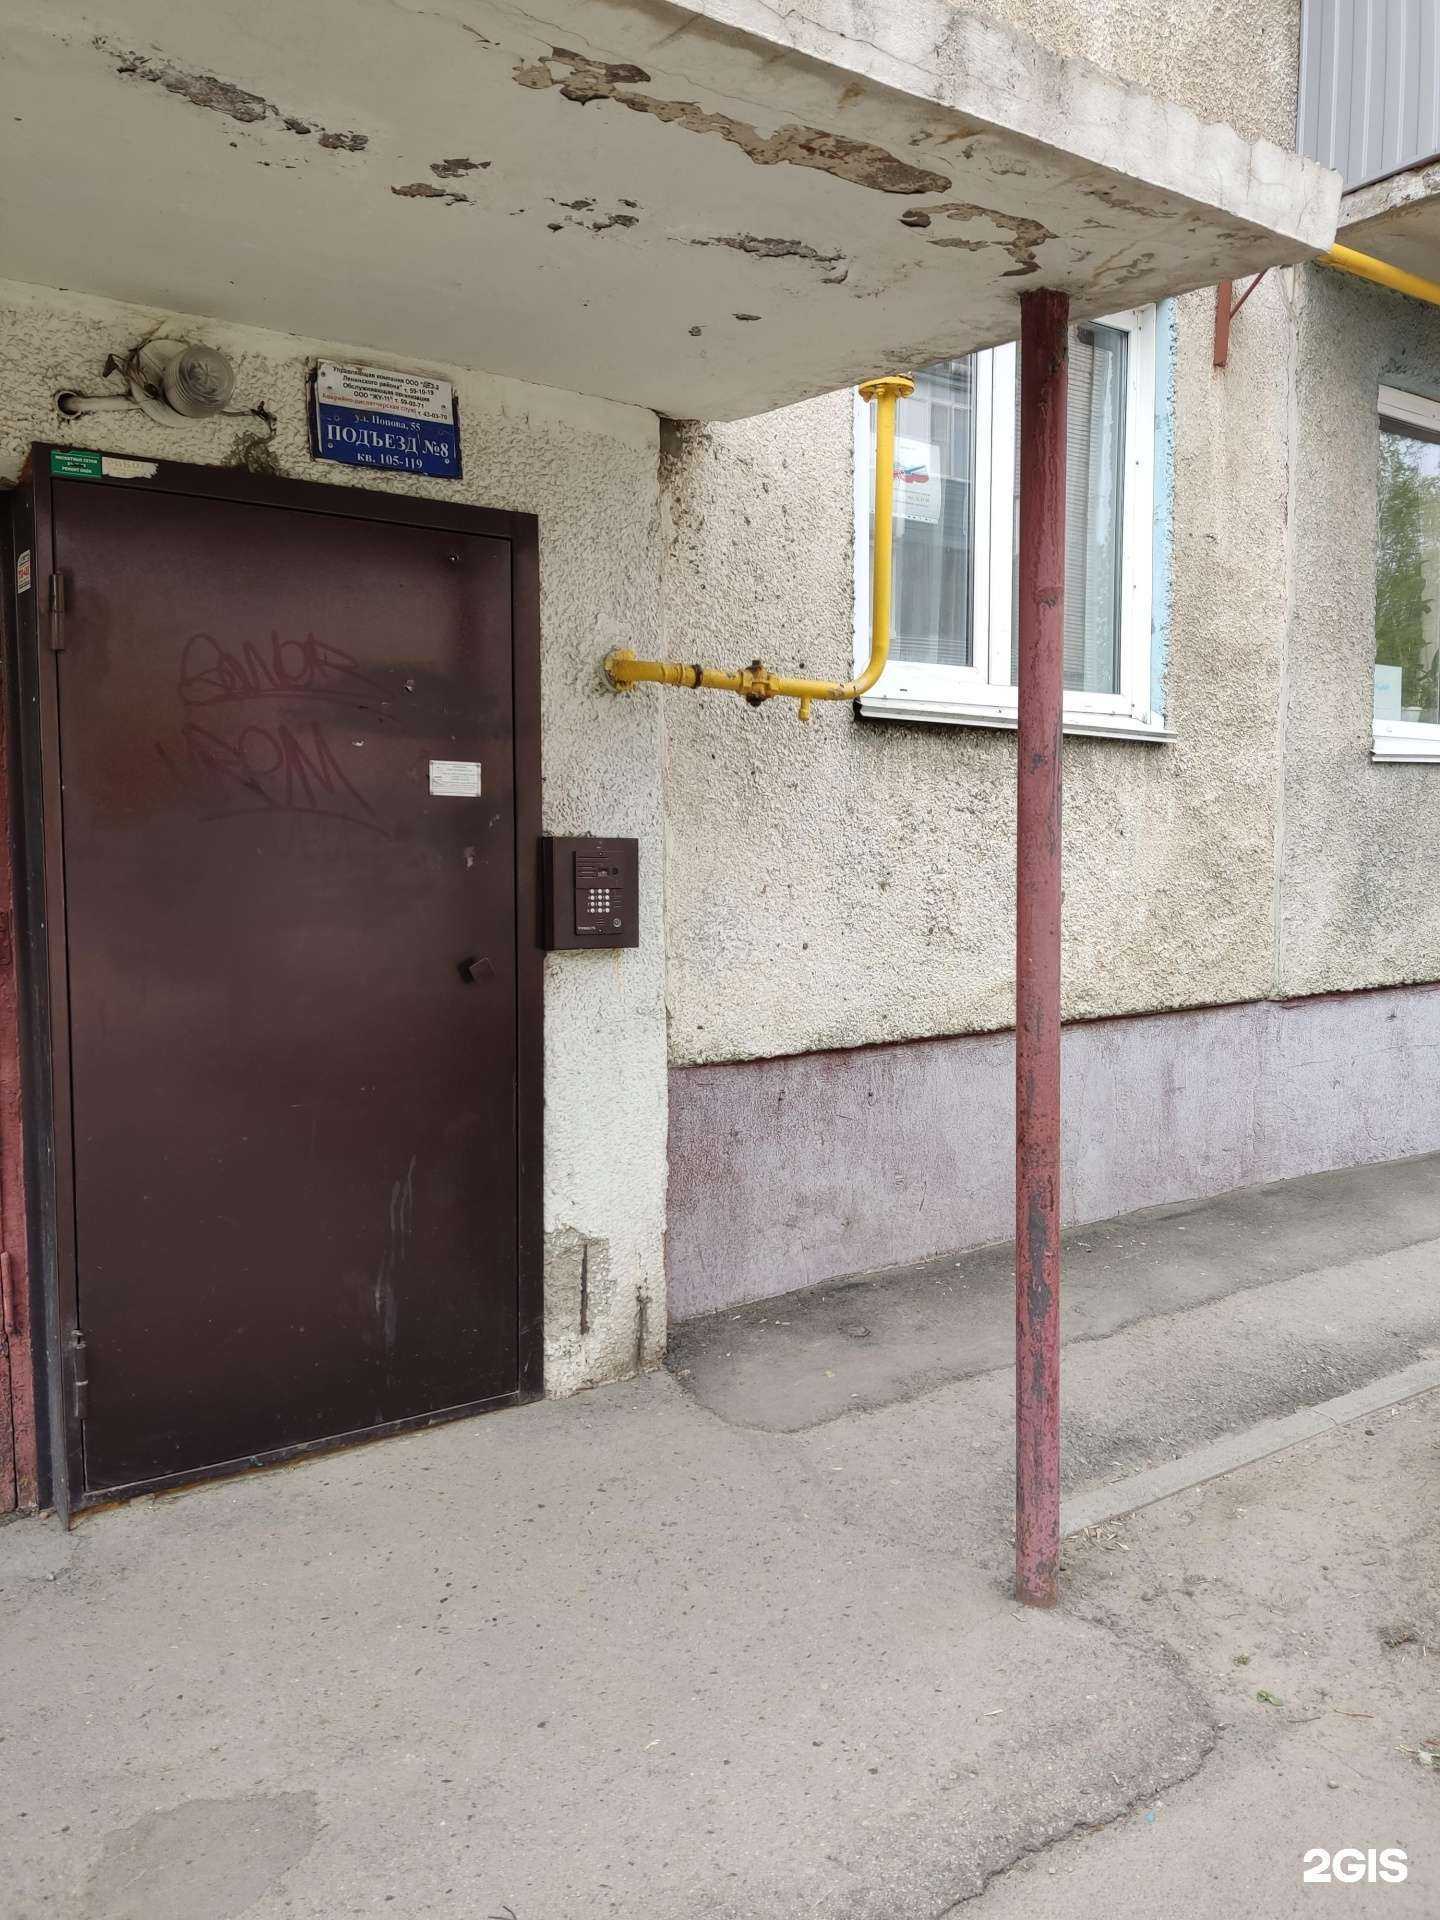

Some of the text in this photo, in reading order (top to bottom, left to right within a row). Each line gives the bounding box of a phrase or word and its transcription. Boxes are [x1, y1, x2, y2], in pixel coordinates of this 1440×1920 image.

[343, 375, 379, 387] Ленинского
[377, 373, 404, 384] компания
[405, 378, 419, 387] ООО
[343, 382, 430, 403] Обслуживающая организация
[353, 390, 369, 399] ООО
[410, 421, 421, 431] 55
[327, 424, 449, 458] ПОДЪЕЗД №8
[380, 453, 423, 469] 105-119
